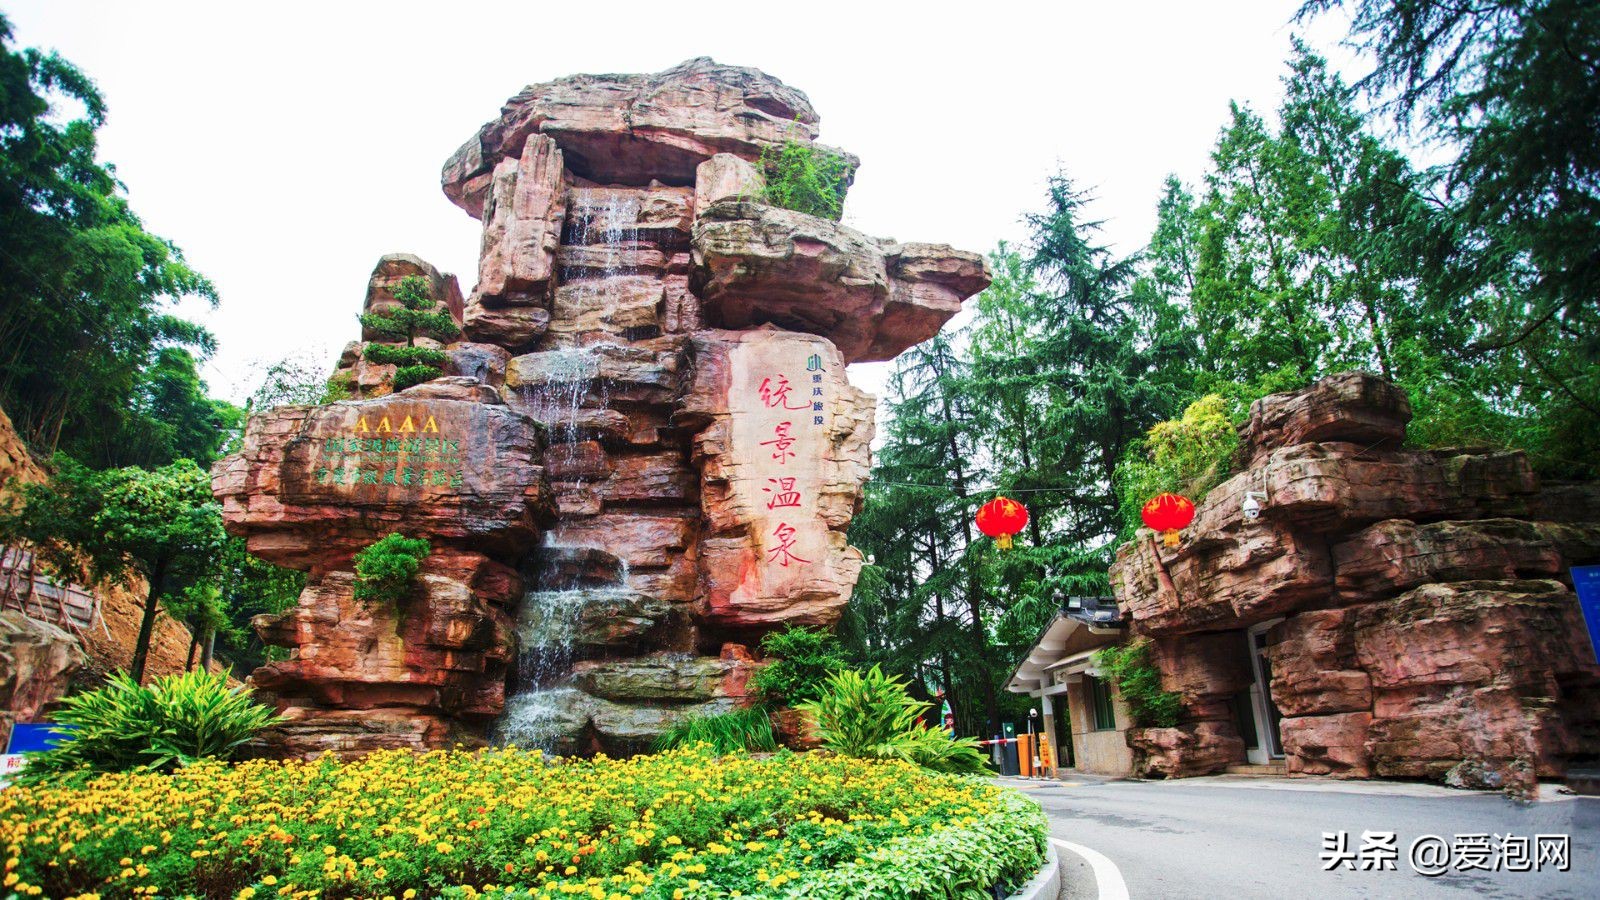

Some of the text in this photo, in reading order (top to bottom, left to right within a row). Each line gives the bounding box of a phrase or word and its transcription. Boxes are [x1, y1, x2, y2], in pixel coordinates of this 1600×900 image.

[812, 374, 825, 426] 重庆旅投
[757, 373, 813, 568] 统景温泉
